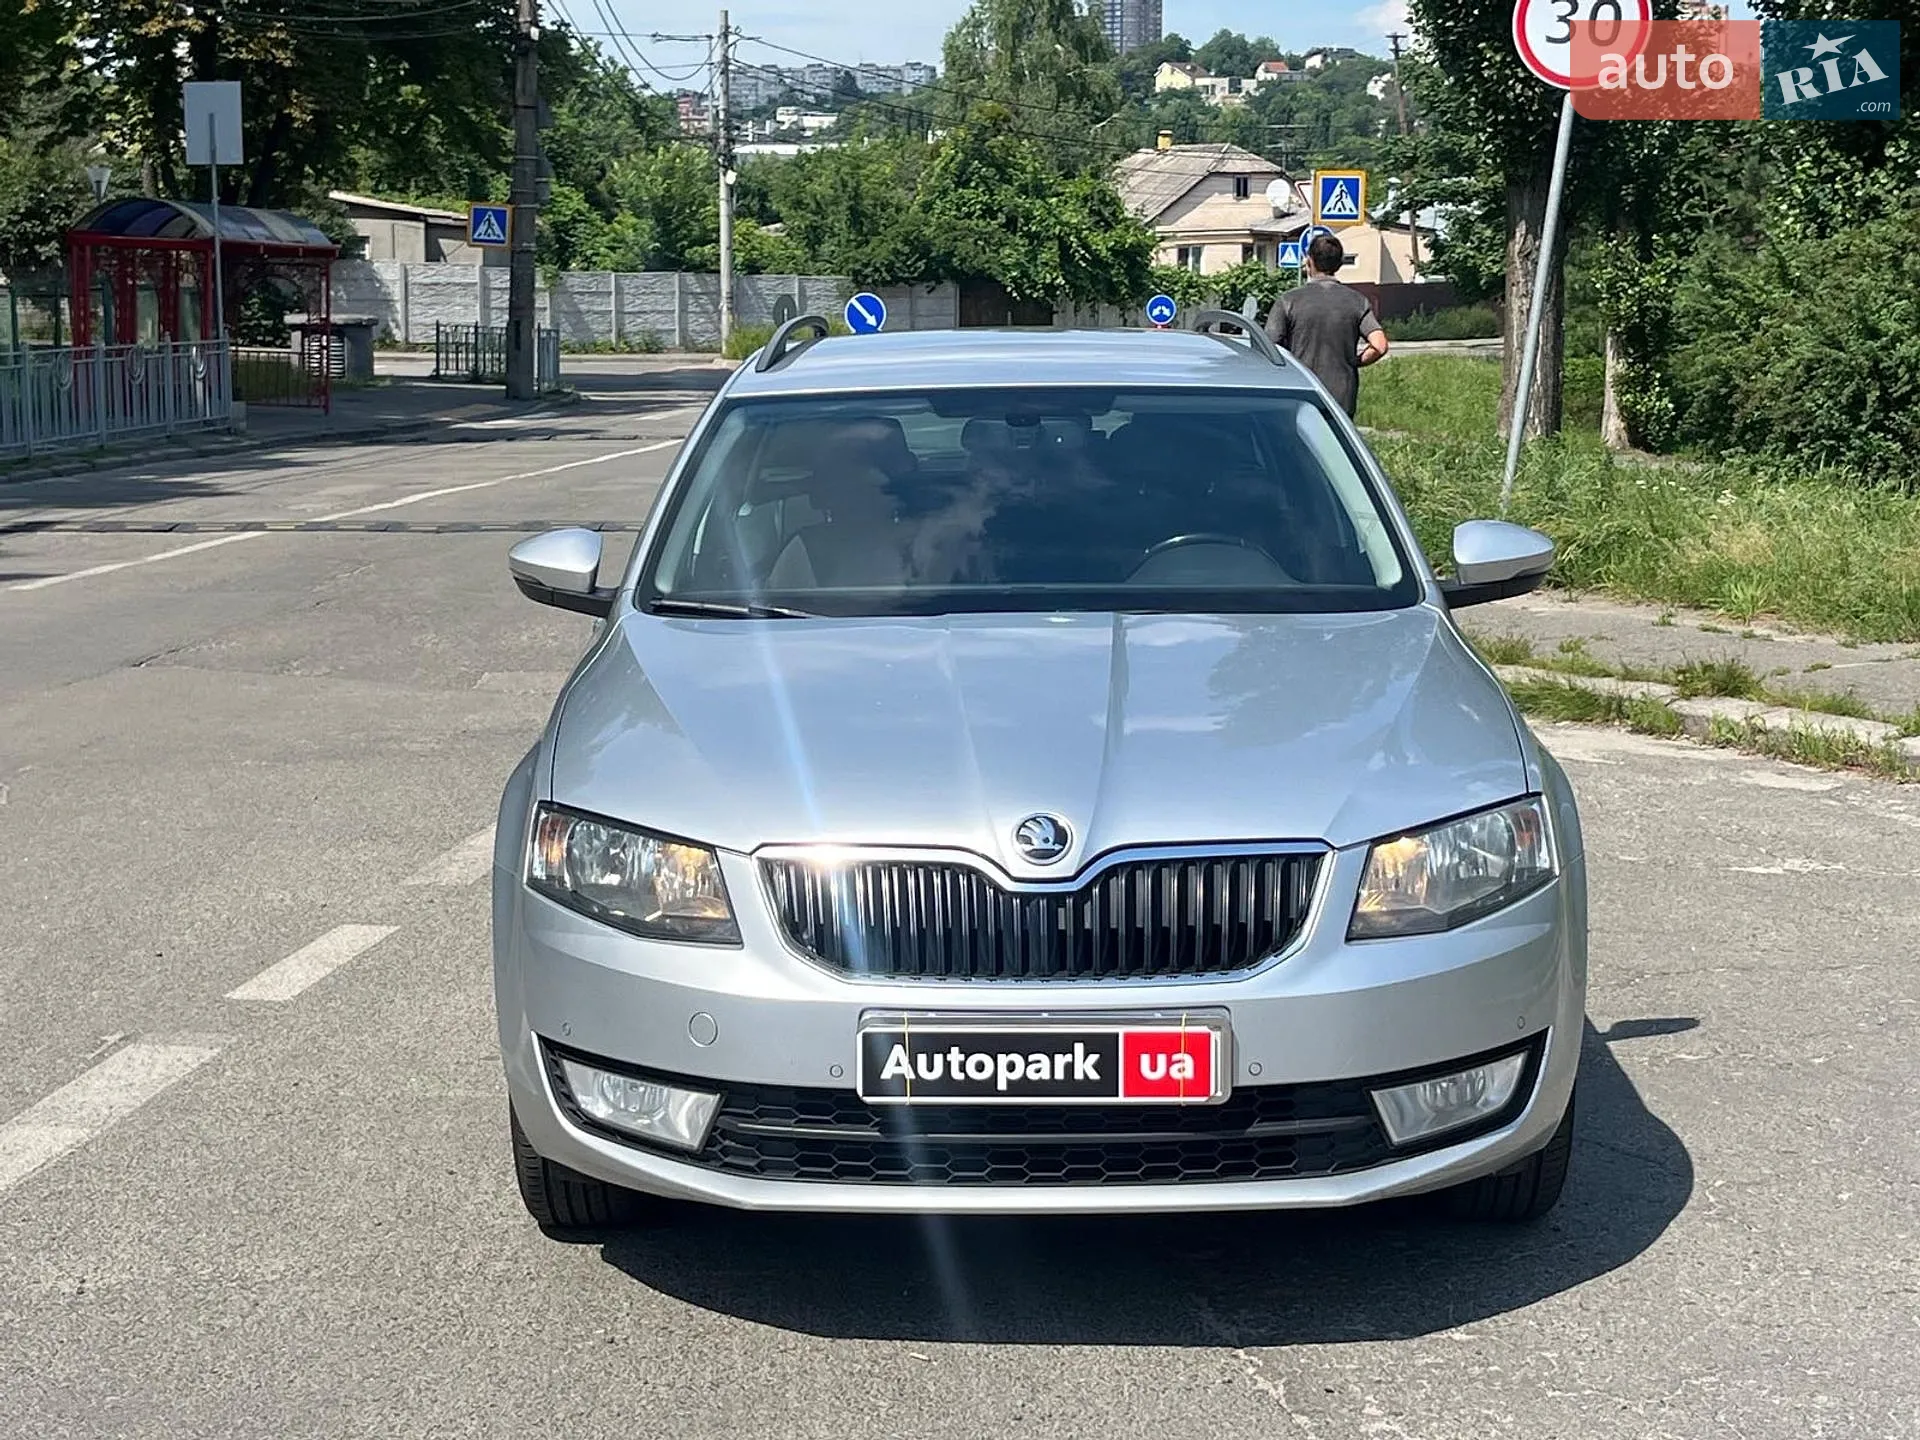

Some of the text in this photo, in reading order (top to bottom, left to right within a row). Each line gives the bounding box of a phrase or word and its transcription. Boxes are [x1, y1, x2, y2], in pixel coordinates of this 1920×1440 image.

[1545, 0, 1623, 47] 30
[880, 1042, 1195, 1091] Autopark ua
